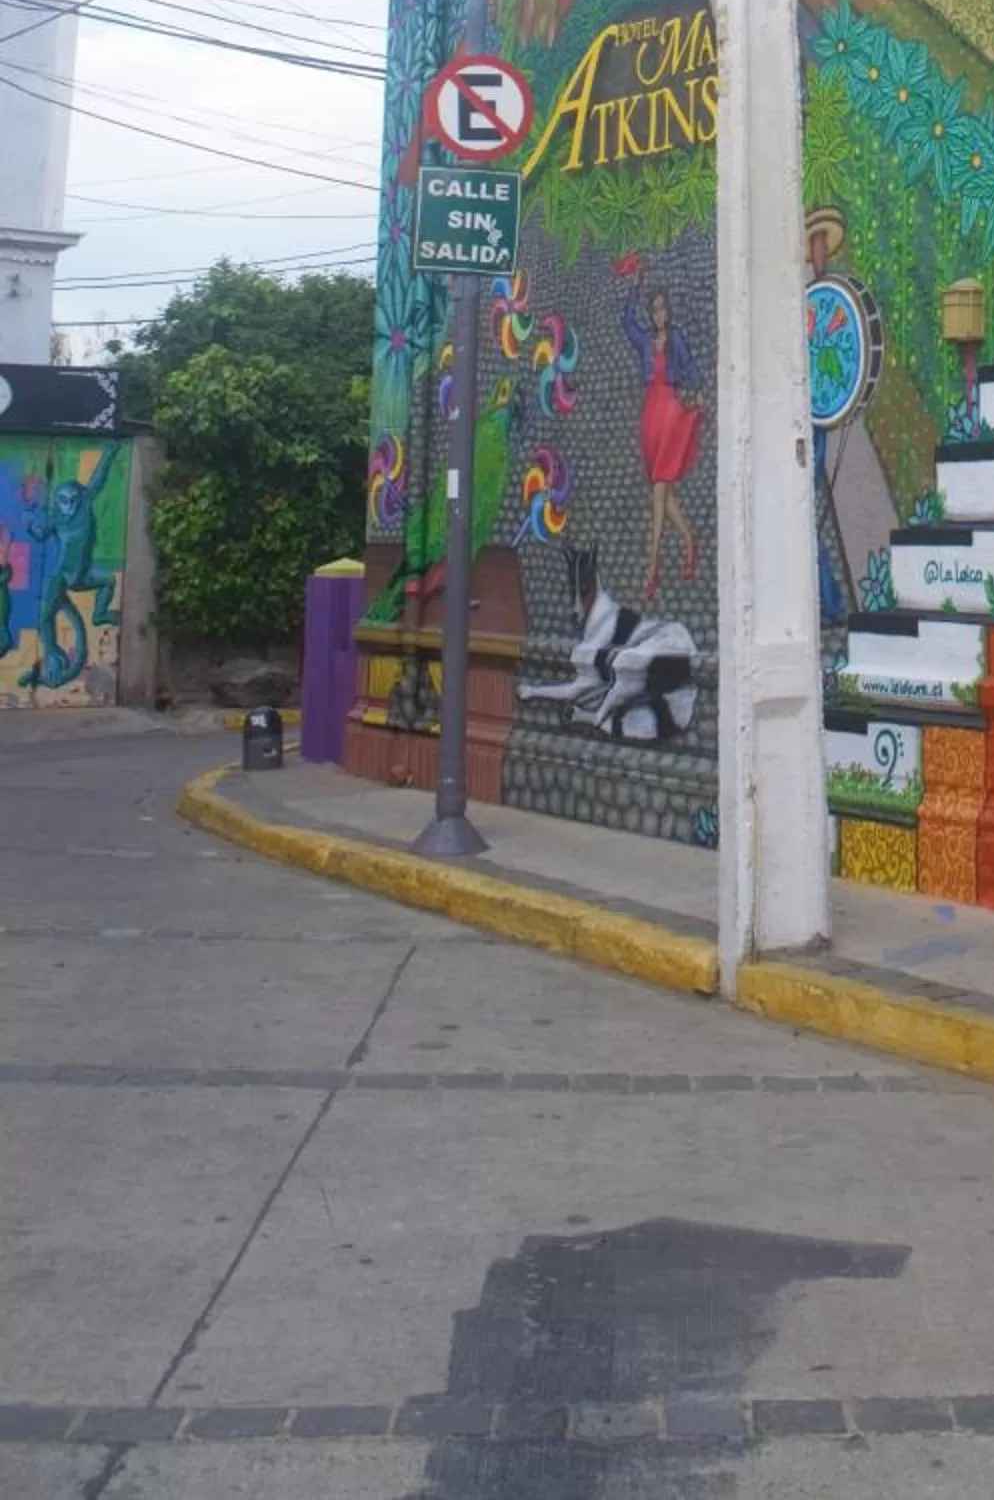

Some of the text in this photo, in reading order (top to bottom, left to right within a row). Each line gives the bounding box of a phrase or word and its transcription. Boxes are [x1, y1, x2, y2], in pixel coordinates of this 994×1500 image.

[614, 8, 718, 85] HOTEL MA
[521, 24, 720, 178] ATKINS
[427, 179, 511, 201] CALLE
[447, 209, 493, 231] SIN
[419, 241, 512, 265] SALIDA
